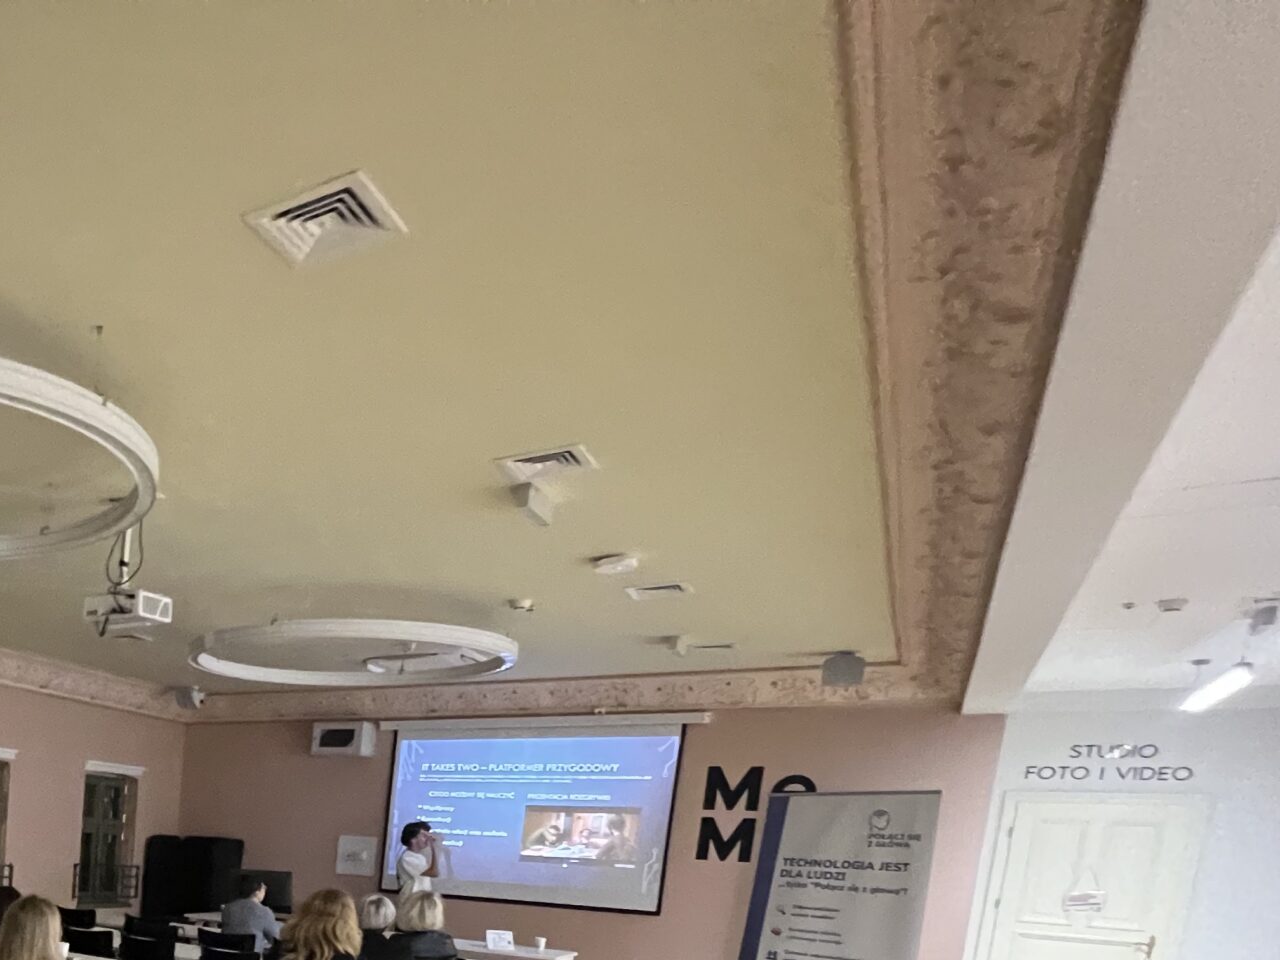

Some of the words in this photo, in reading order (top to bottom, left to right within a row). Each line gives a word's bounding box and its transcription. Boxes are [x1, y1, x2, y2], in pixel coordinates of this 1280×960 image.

[1069, 743, 1159, 759] STUDIO
[431, 763, 455, 771] TAKES
[457, 763, 480, 772] TWO
[488, 763, 544, 772] PLATFORMER
[546, 763, 620, 773] PRZYGODOWY
[1023, 765, 1090, 781] FOTO
[1099, 766, 1105, 780] I
[1116, 766, 1193, 781] VIDEO
[783, 857, 875, 871] TECHNOLOGIA
[878, 862, 911, 872] JEST
[780, 868, 804, 879] DLA
[806, 870, 847, 881] LUDZI
